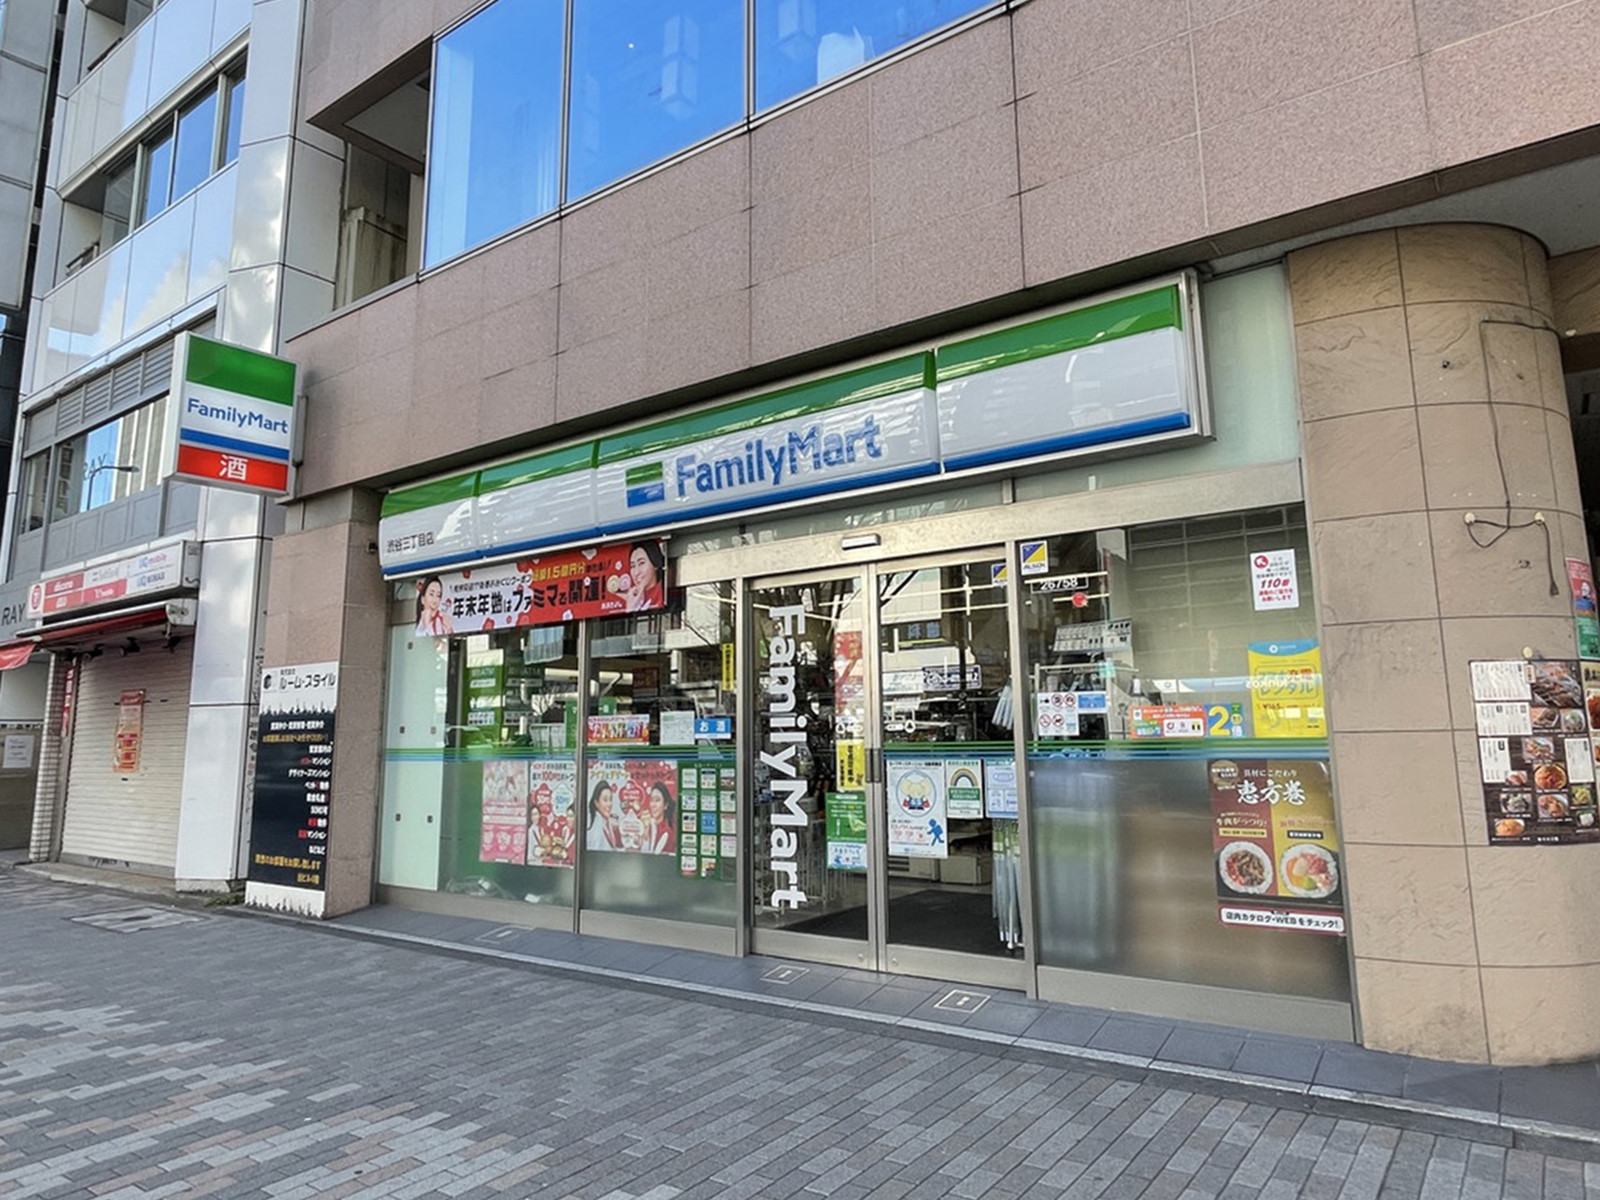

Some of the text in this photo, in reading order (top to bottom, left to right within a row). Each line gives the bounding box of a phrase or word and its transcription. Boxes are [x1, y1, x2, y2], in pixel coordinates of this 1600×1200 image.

[187, 398, 288, 434] FamilyMart
[219, 454, 249, 481] 酒
[675, 414, 883, 497] FamilyMart
[1, 603, 25, 626] RAY
[759, 604, 809, 910] FamilyMart
[1237, 779, 1307, 806] 恵方巻
